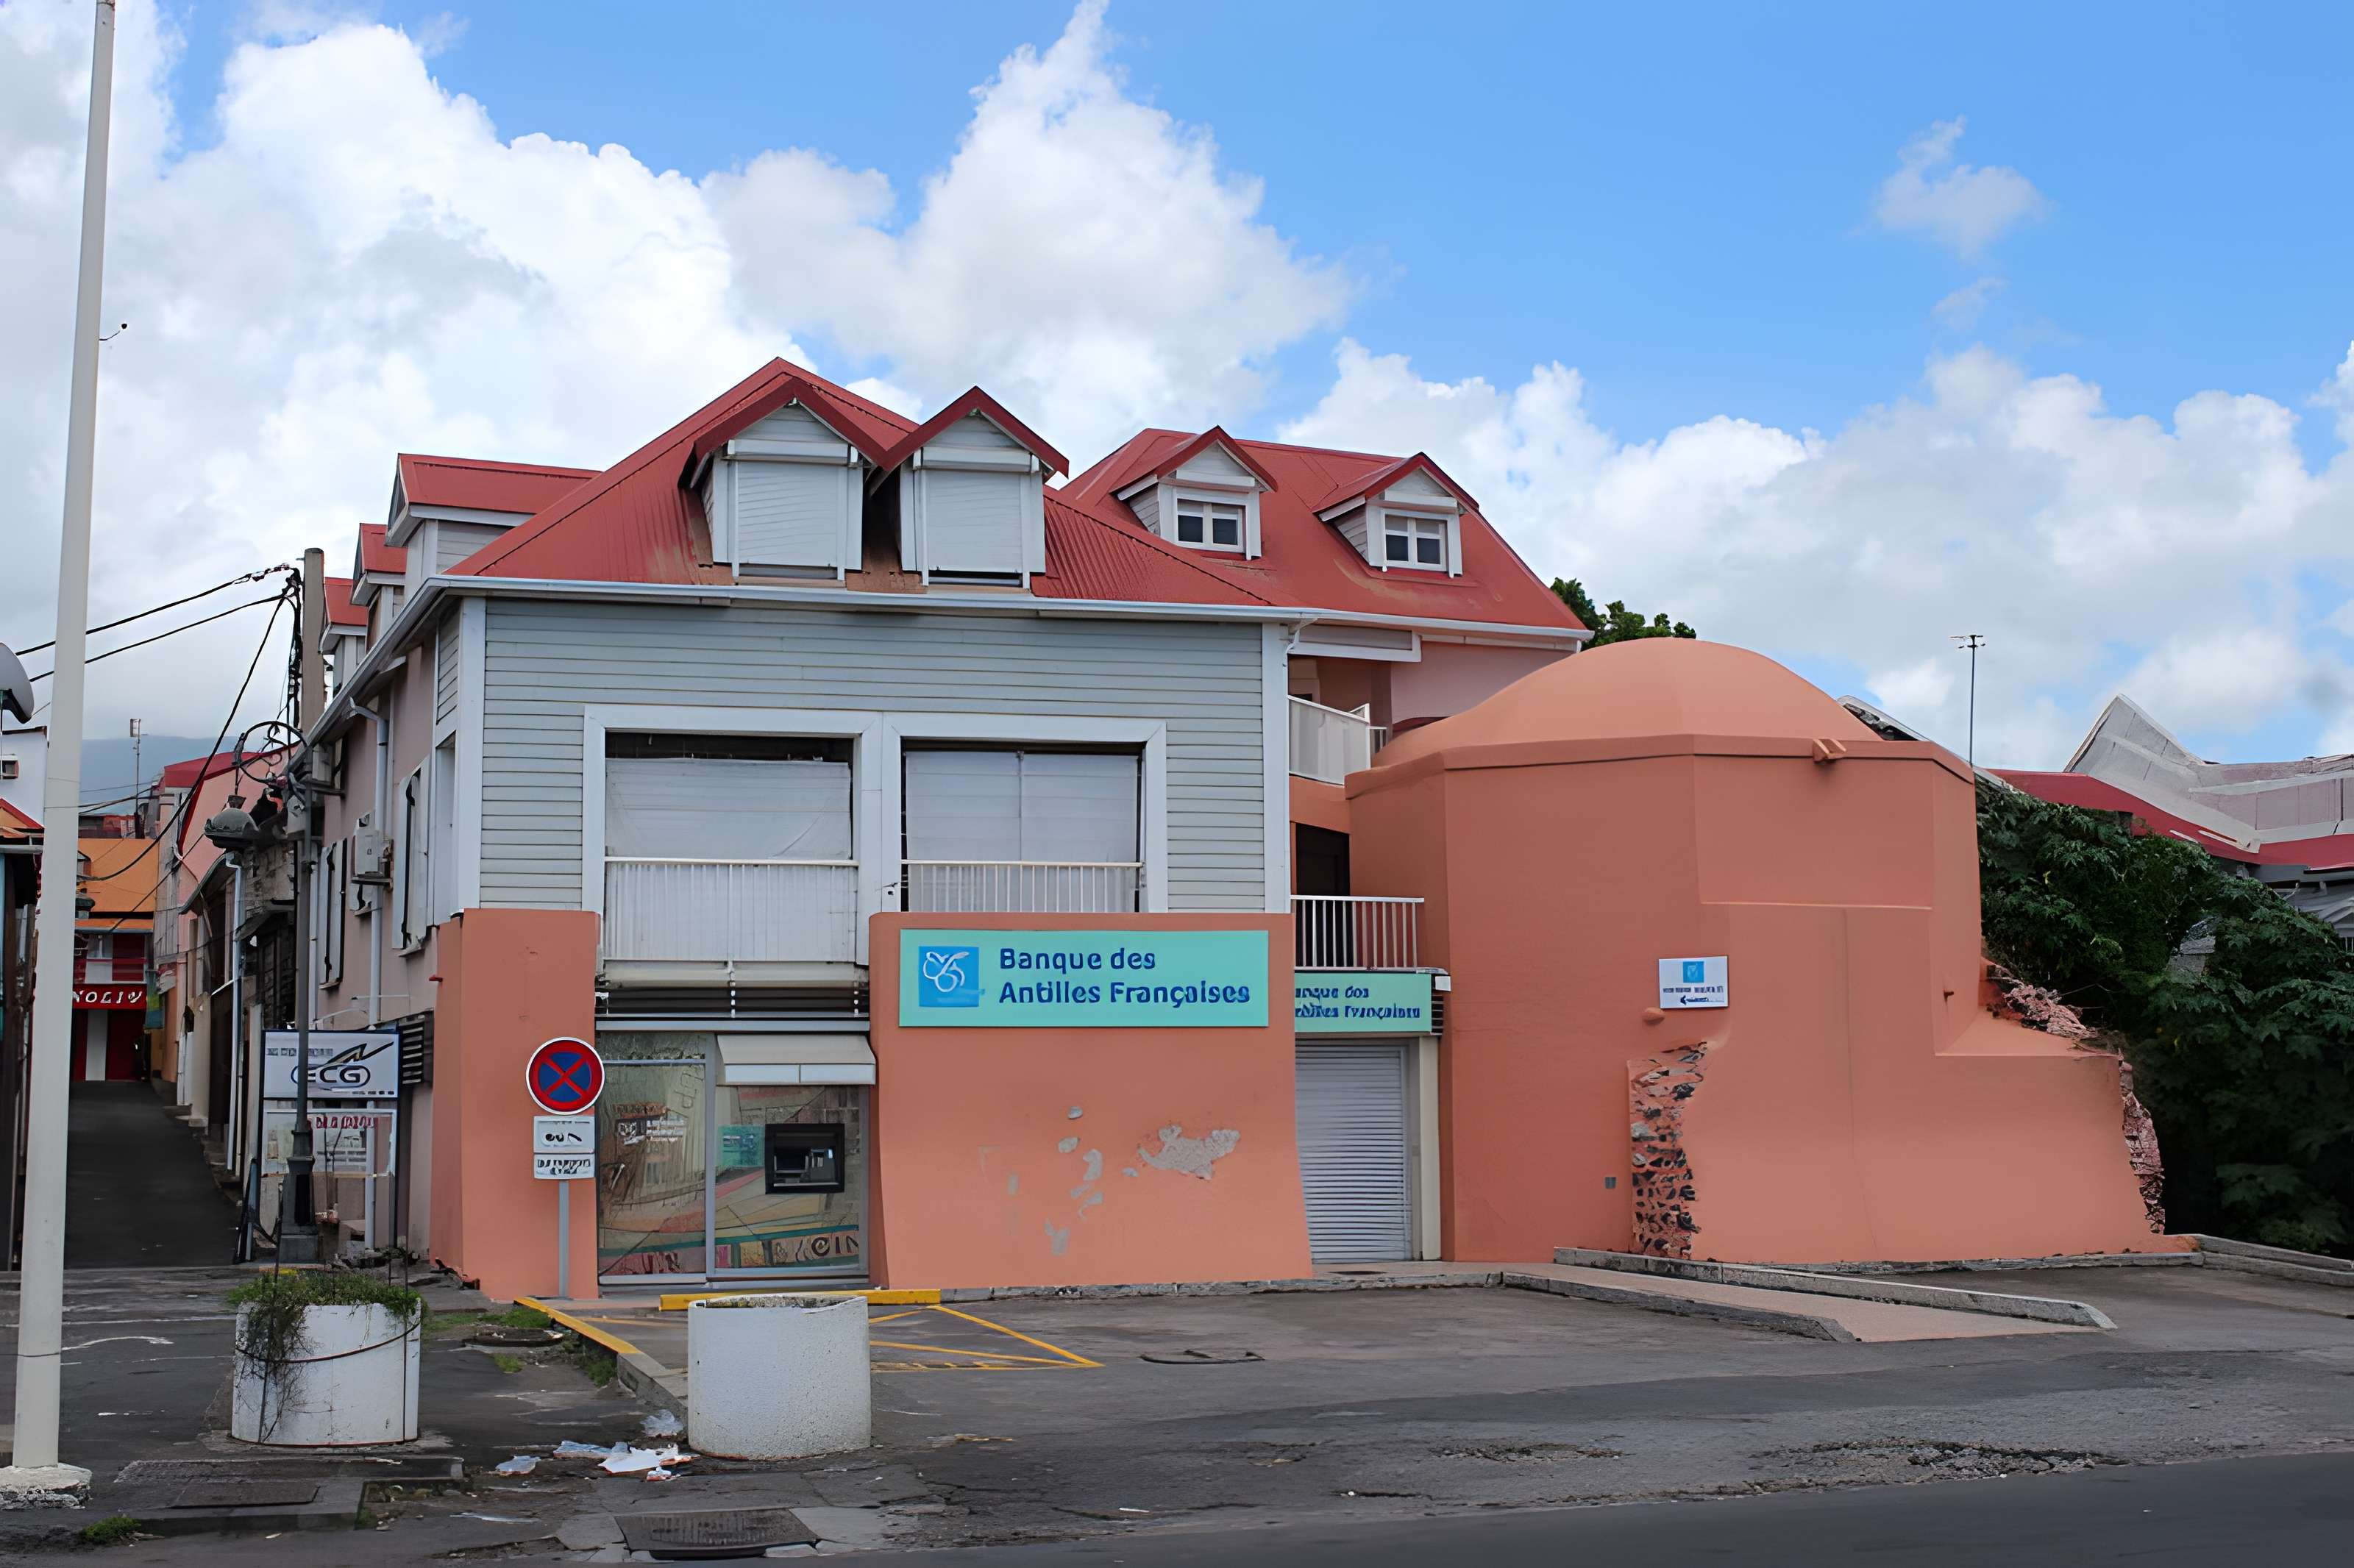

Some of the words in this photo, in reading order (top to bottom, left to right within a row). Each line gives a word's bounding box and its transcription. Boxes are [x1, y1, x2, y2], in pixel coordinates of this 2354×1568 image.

[1000, 948, 1102, 974] Banque
[1110, 947, 1156, 969] des
[999, 980, 1100, 1004] Antilles
[1110, 980, 1251, 1008] Françaises
